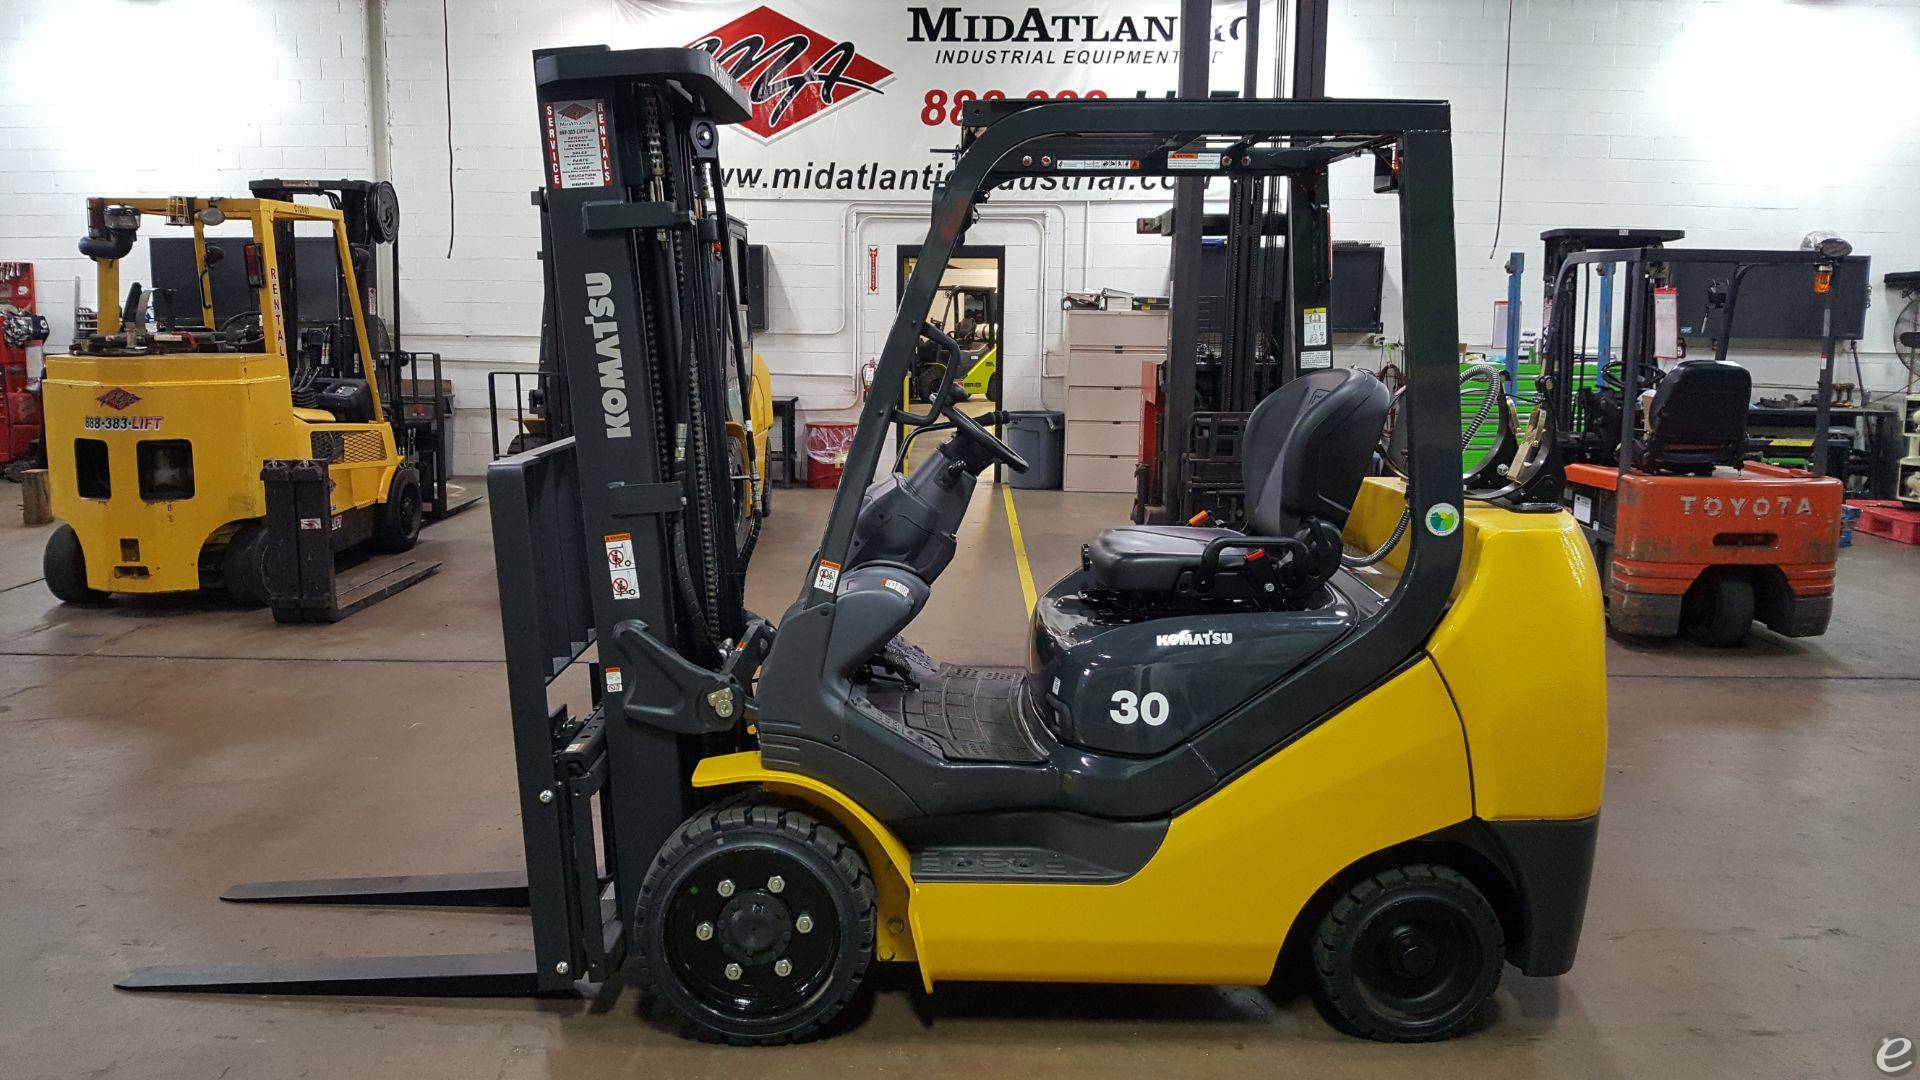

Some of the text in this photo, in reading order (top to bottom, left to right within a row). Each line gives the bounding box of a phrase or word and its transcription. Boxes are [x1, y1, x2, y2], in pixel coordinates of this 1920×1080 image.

[935, 50, 1055, 65] INDUSTRIAL
[546, 105, 560, 184] SERVICE
[597, 102, 611, 181] RENTALS
[270, 267, 285, 357] RENTAL
[584, 272, 632, 439] KOMATSU
[1680, 496, 1812, 517] TOYOTA
[1156, 630, 1233, 647] KOMATSU
[1109, 690, 1170, 726] 30
